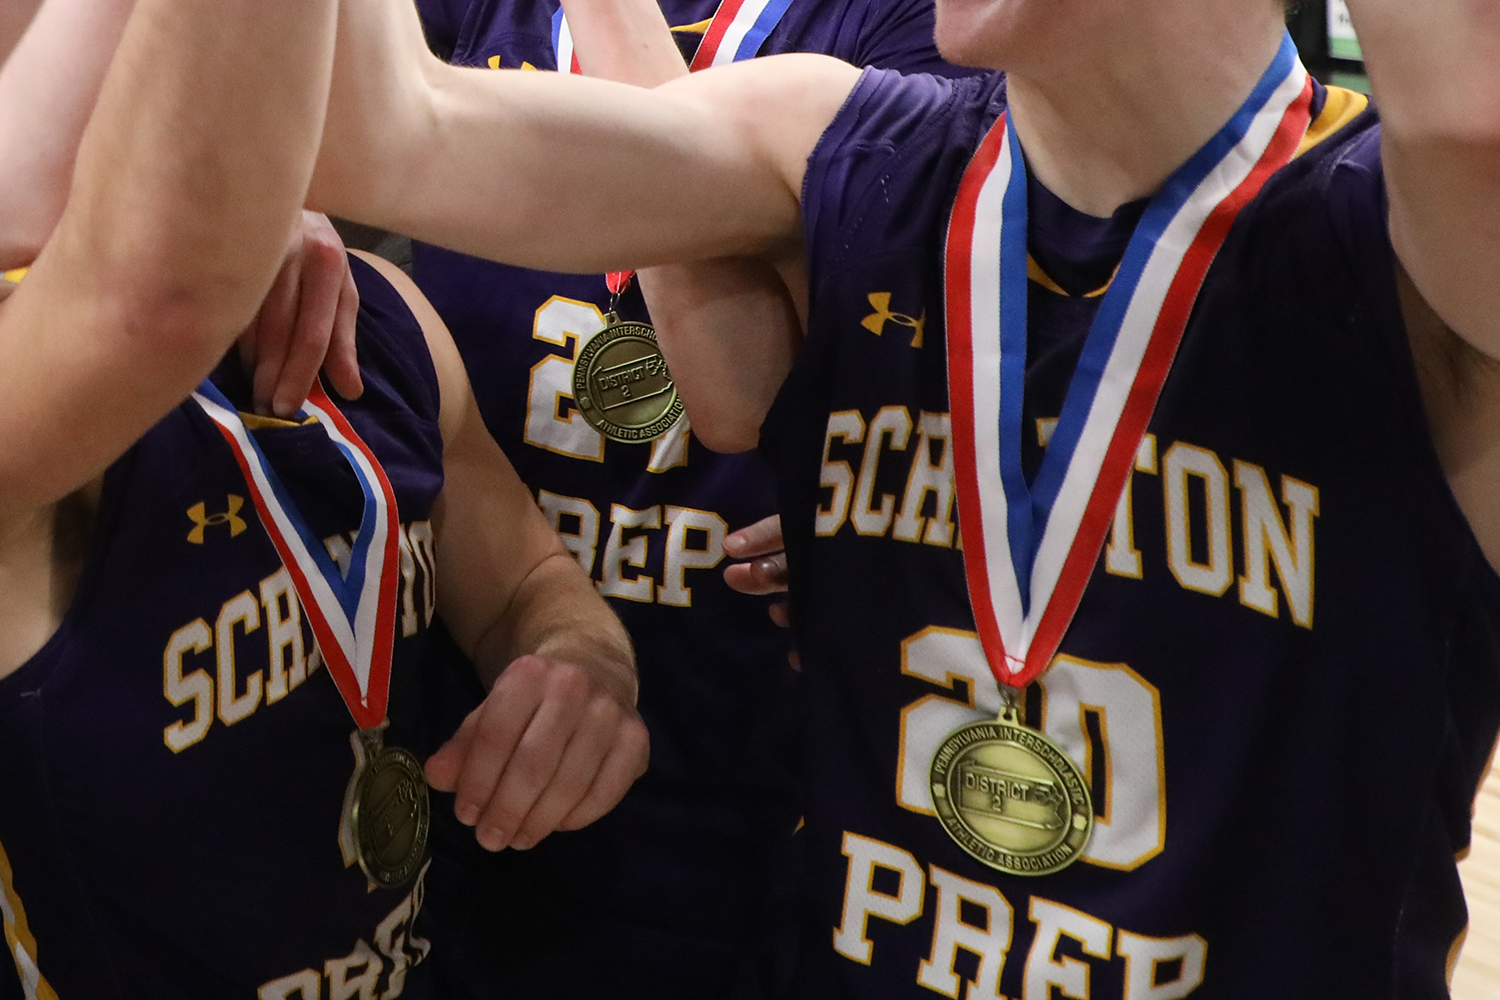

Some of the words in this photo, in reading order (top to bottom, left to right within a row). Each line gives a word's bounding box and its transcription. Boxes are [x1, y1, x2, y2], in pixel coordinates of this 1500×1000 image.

[599, 366, 644, 390] DISTRICT
[597, 420, 638, 439] ATHLETIC
[814, 404, 1320, 631] SCRTON
[538, 490, 729, 608] REP
[895, 625, 1167, 872] 20
[934, 726, 997, 776] PENNSYLVANIA
[999, 728, 1086, 806] INTERSCHOLASTIC
[965, 772, 1030, 801] DISTRICT
[992, 795, 1002, 812] 2
[947, 819, 995, 861] ATHLETIC
[998, 843, 1074, 871] ASSOCIATION
